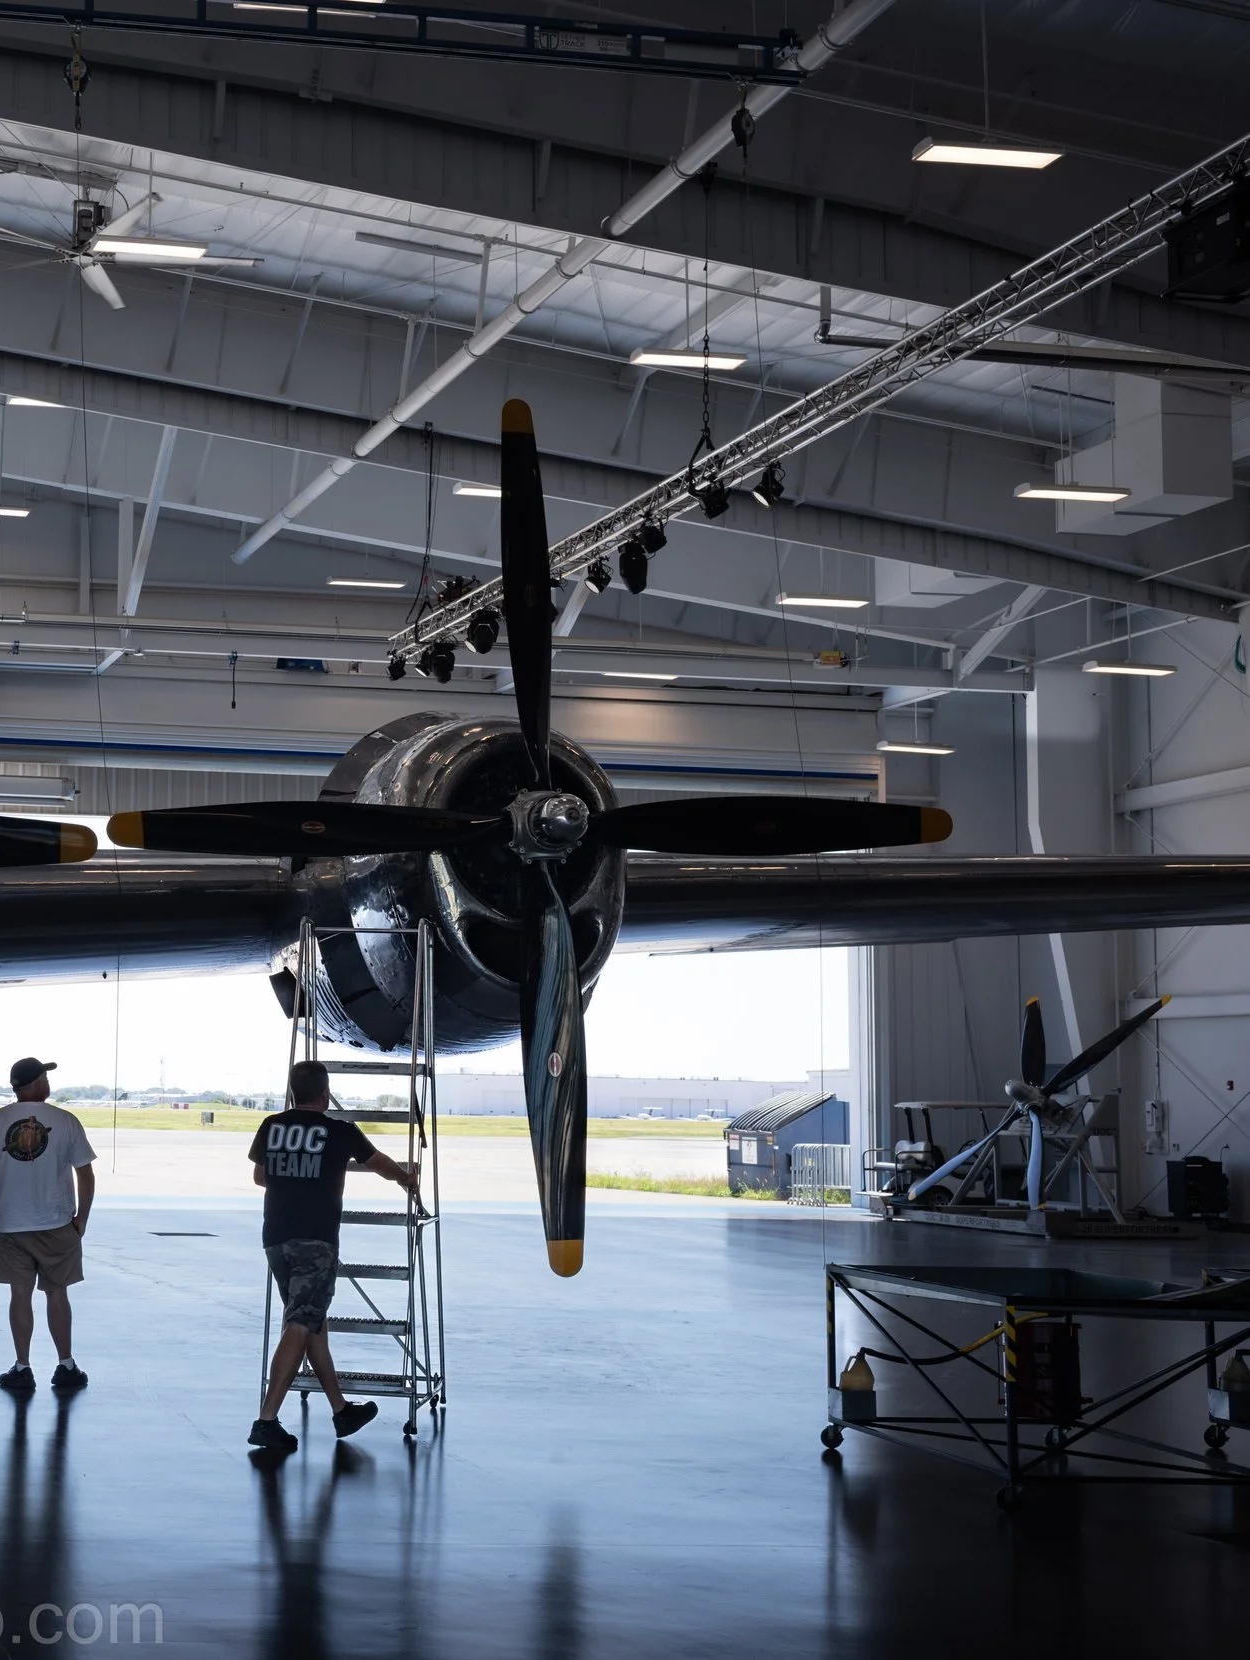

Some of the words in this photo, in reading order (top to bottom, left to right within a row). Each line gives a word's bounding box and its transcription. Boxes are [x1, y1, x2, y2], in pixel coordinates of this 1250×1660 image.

[560, 40, 586, 48] TRACK
[266, 1123, 328, 1153] DOC
[266, 1152, 322, 1178] TEAM
